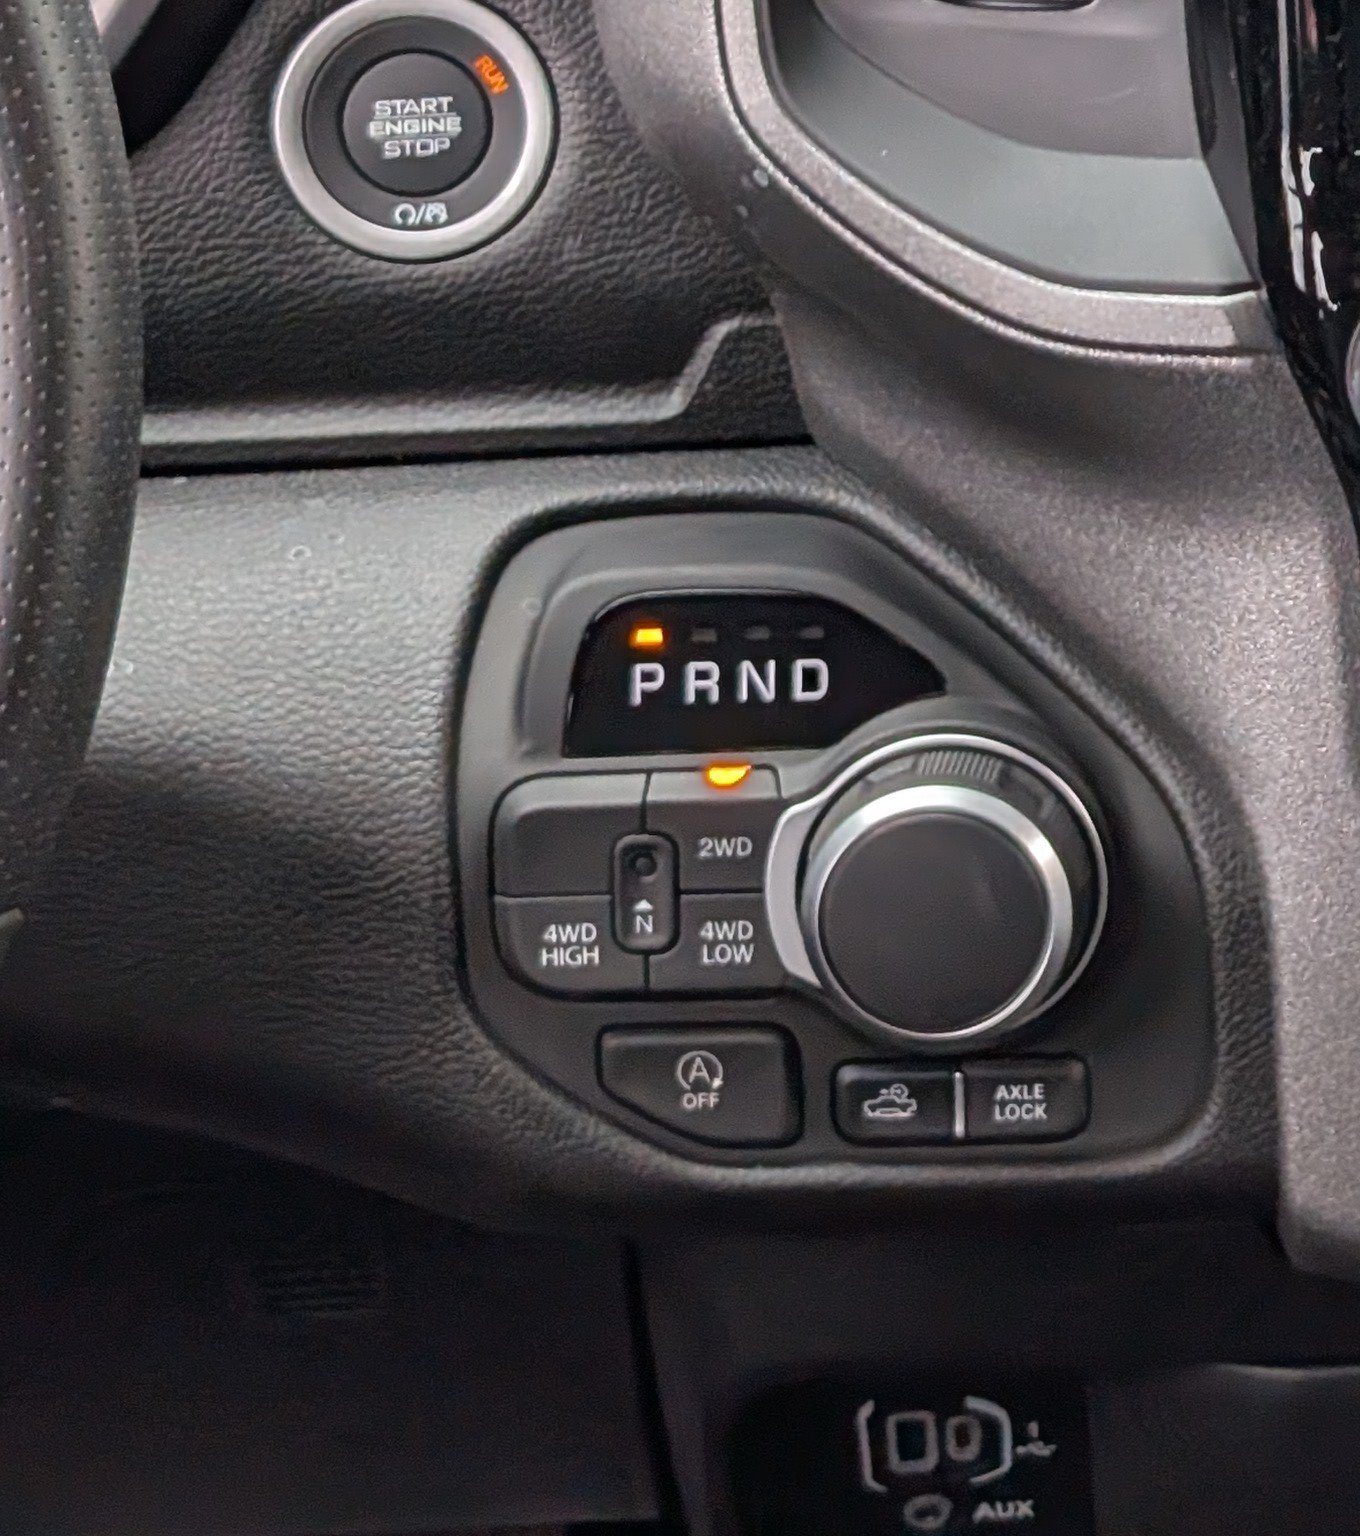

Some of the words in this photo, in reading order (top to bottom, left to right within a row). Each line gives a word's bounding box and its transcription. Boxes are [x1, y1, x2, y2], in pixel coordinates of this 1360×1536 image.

[475, 54, 510, 95] RUN
[374, 96, 454, 116] START
[369, 116, 463, 139] ENGINE
[382, 138, 451, 159] STOP
[698, 837, 753, 857] 2WD
[543, 922, 597, 943] 4WD
[700, 920, 754, 941] 4WD
[541, 945, 600, 966] HIGH
[702, 943, 754, 964] LOW
[682, 1090, 720, 1109] OFF
[993, 1082, 1045, 1102] AXLE
[993, 1100, 1048, 1121] LOCK
[972, 1499, 1035, 1524] AUX
